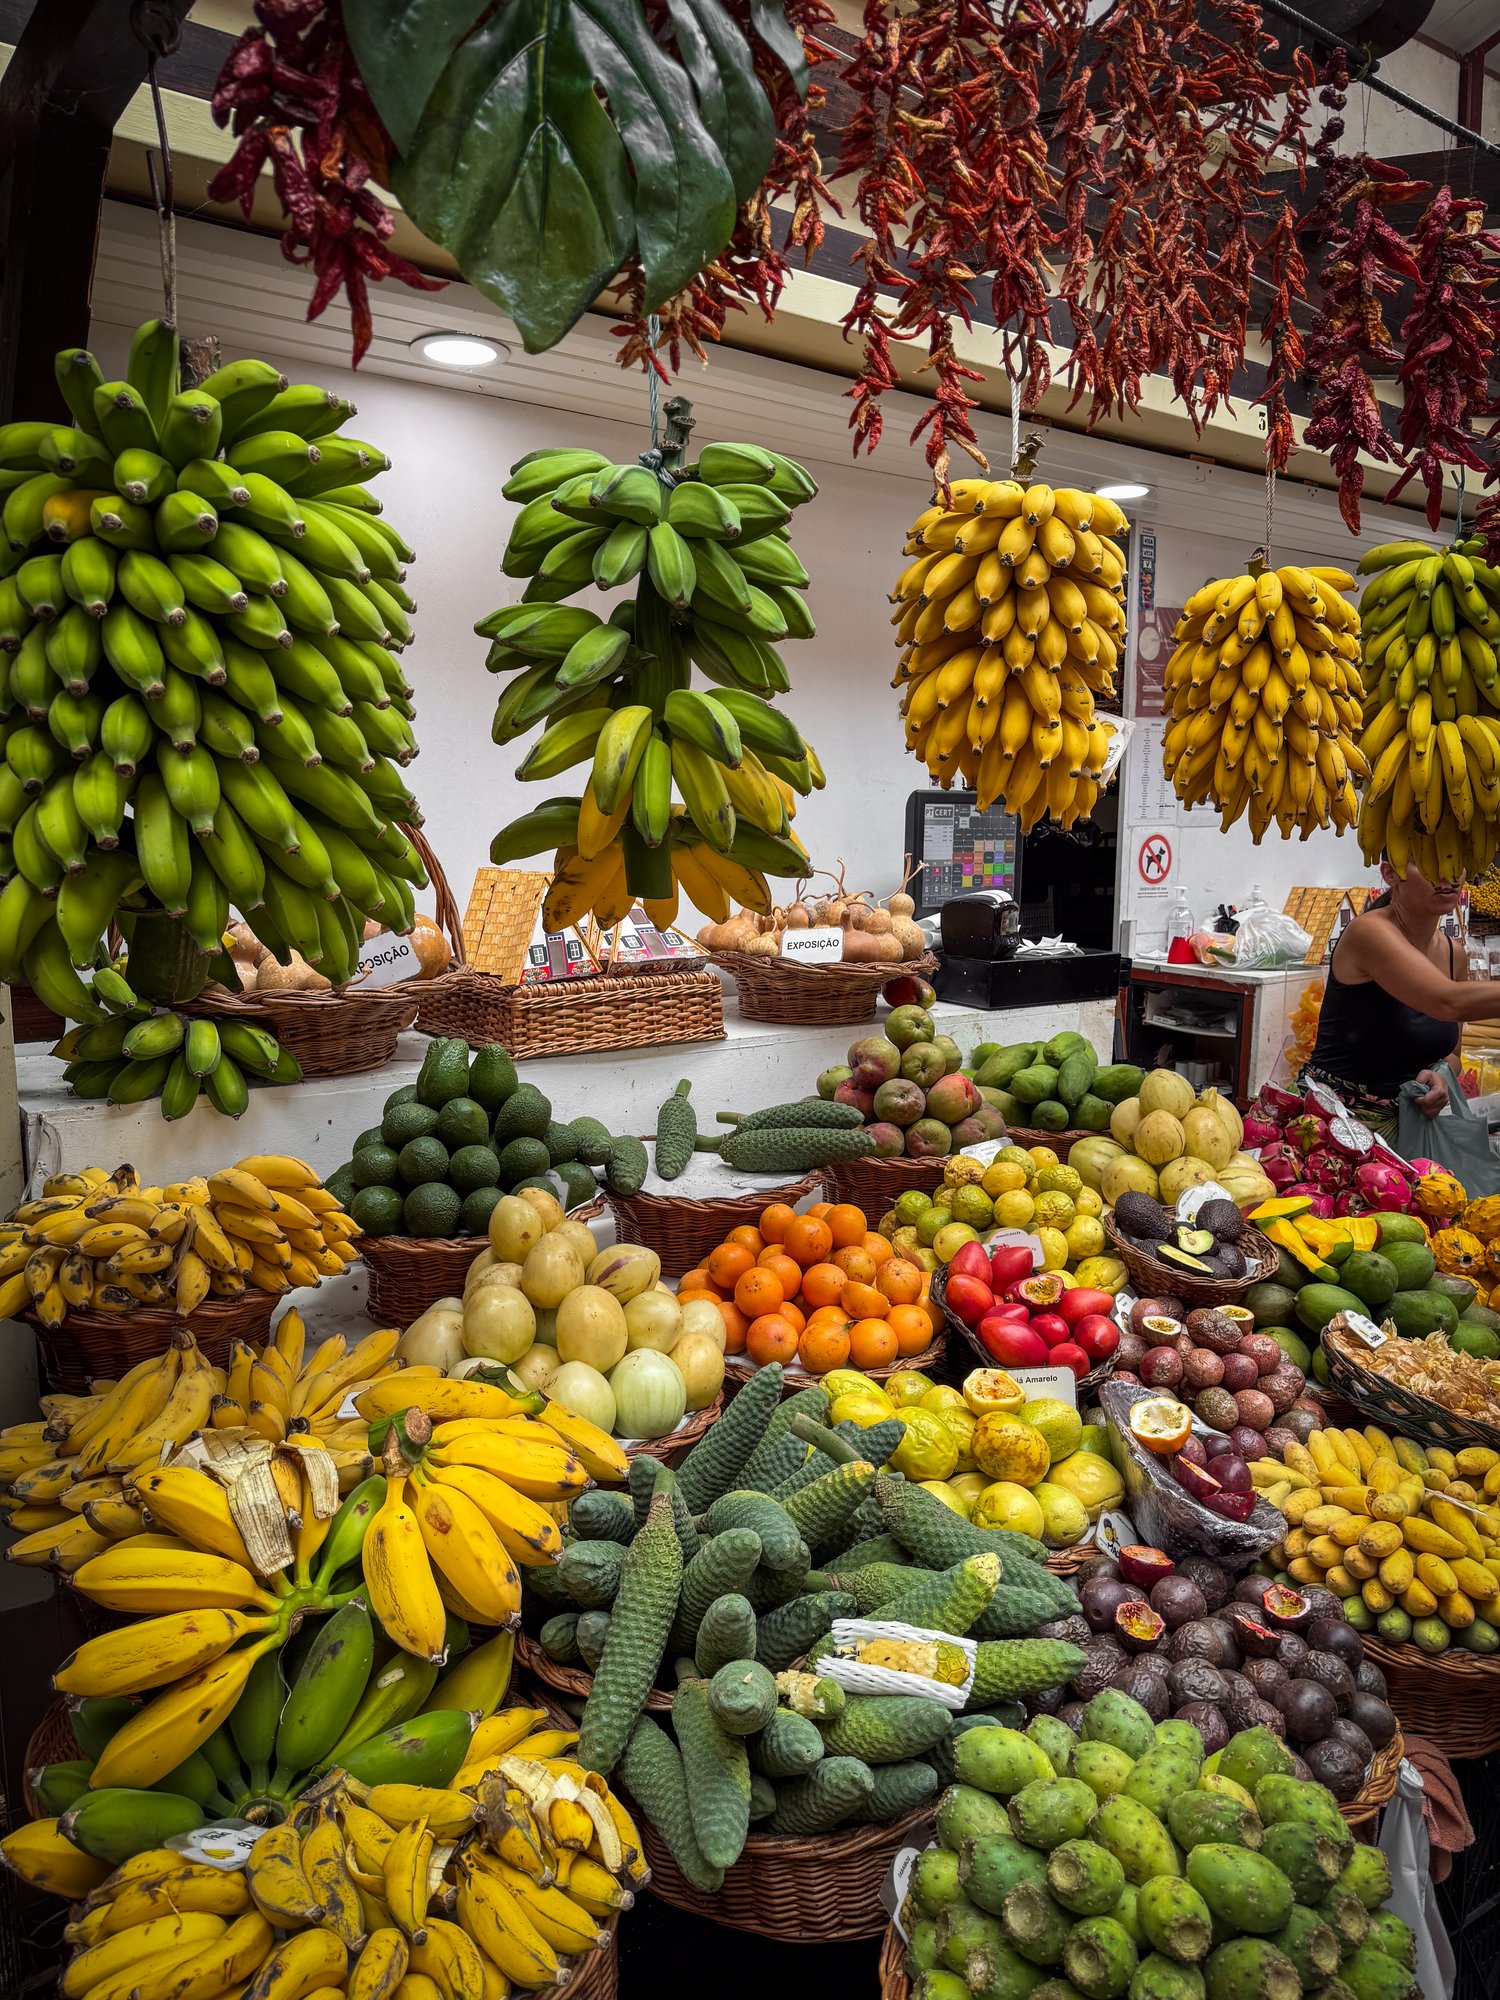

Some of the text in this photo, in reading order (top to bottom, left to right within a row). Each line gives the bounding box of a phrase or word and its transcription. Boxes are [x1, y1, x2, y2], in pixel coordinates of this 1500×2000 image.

[934, 808, 952, 816] CERT
[786, 937, 840, 951] EXPOSIÇÃO
[1025, 1374, 1058, 1384] Amarelo
